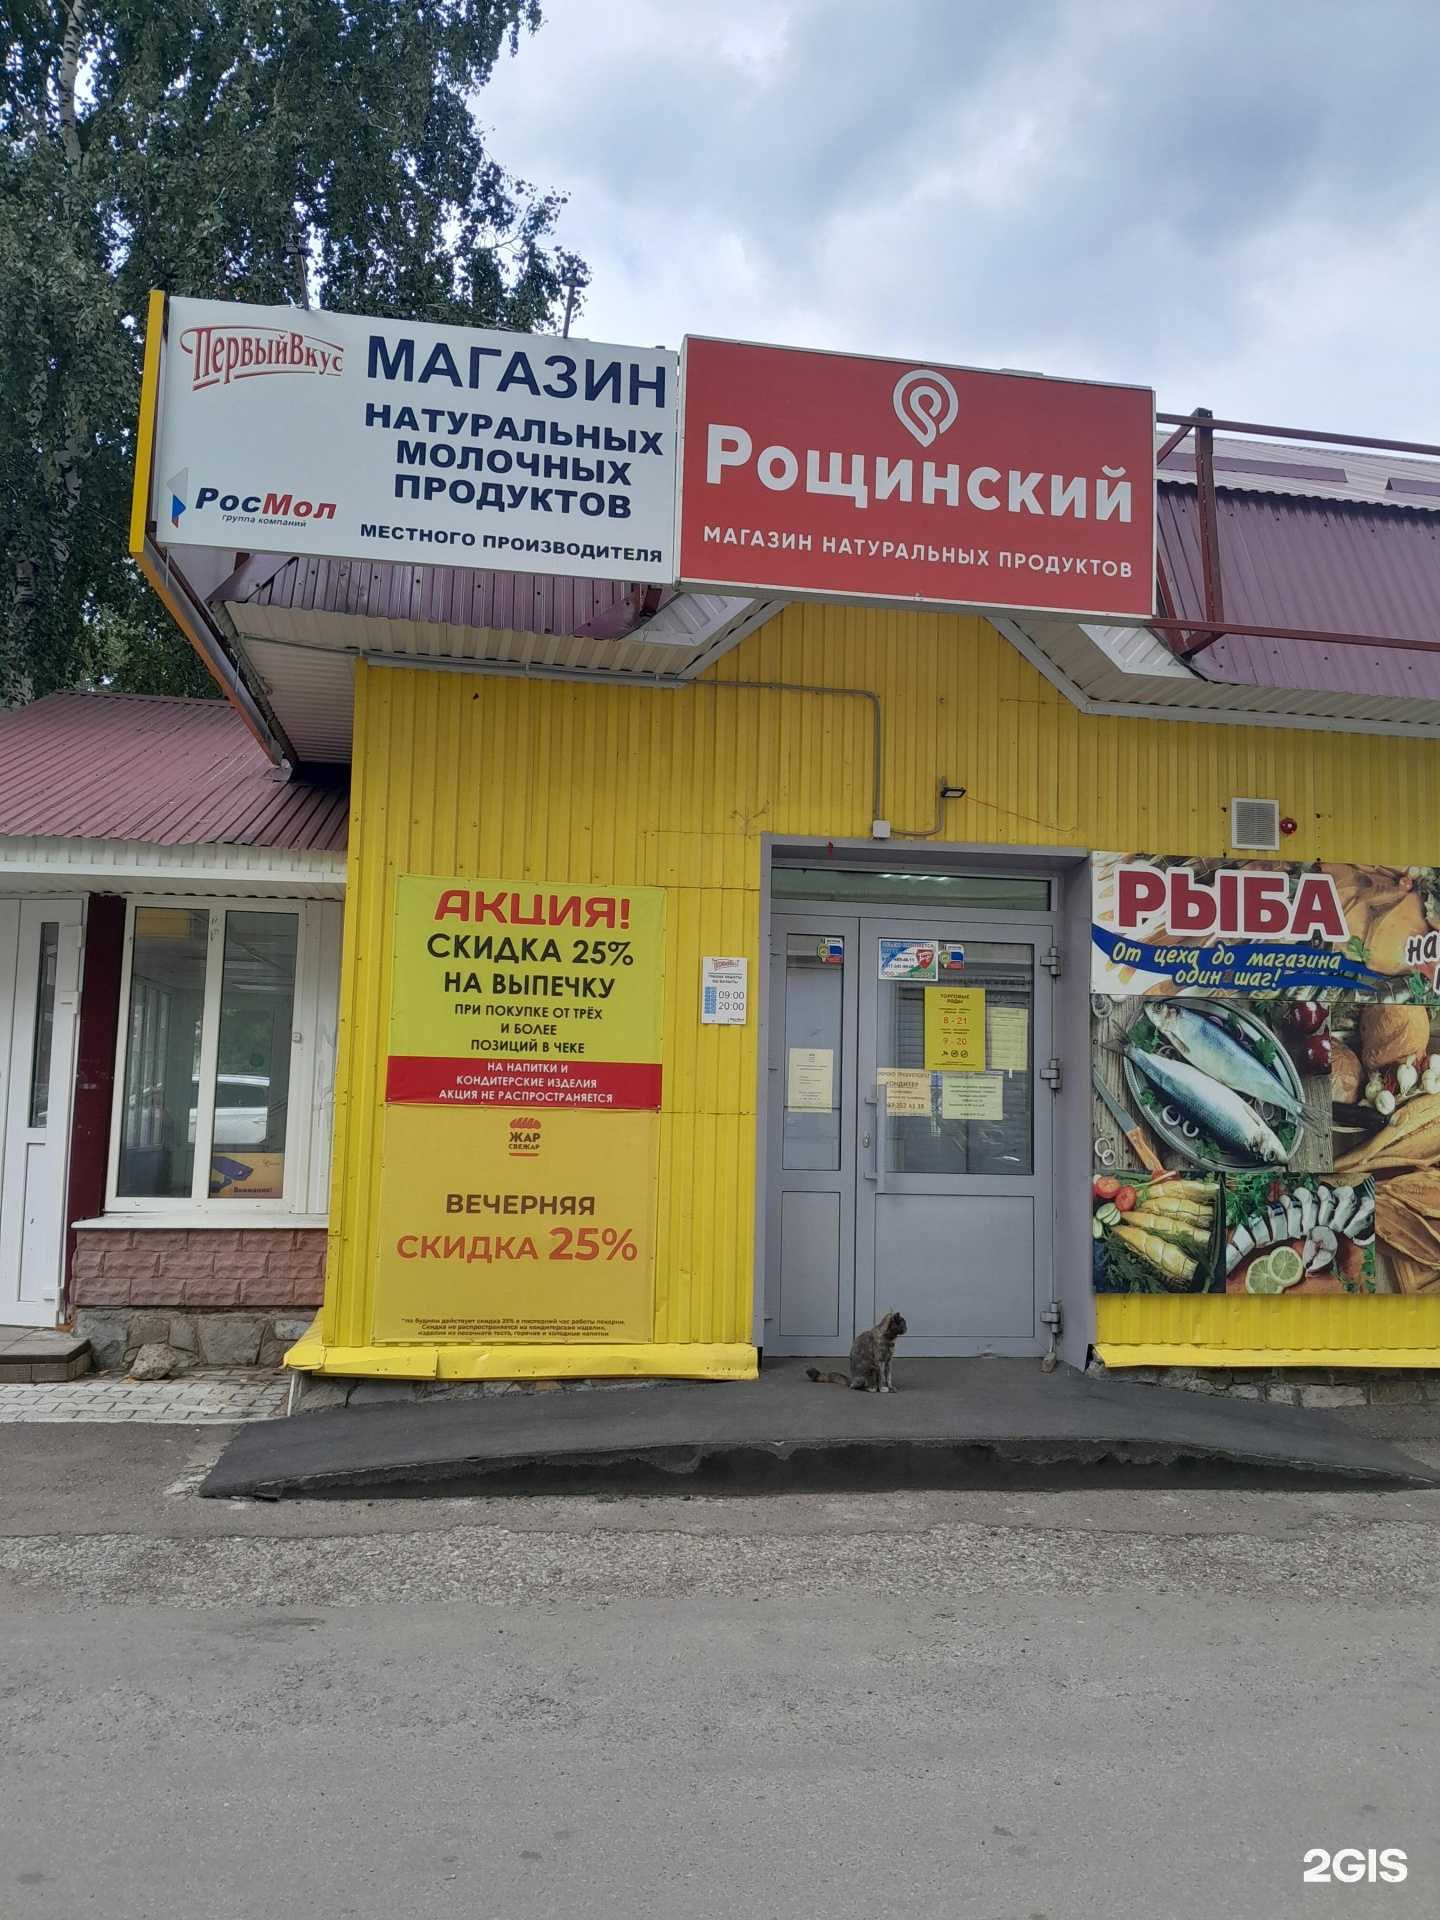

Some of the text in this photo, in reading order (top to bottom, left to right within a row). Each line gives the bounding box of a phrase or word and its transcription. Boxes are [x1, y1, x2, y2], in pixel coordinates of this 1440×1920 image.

[367, 335, 666, 408] МАГАЗИН
[365, 403, 663, 455] НАТУРАЛЬНЫХ
[396, 440, 632, 486] МОЛОЧНЫХ
[195, 487, 337, 520] РосМол
[395, 474, 631, 518] ПРОДУКТОВ
[222, 513, 307, 528] группа компаний
[360, 523, 662, 563] МЕСТНОГО ПРОИЗВОДИТЕЛЯ
[704, 526, 1132, 578] МАГАЗИН НАТУРАЛЬНЫХ ПРОДУКТОВ
[434, 889, 630, 930] АКЦИЯ!
[1118, 870, 1345, 935] РЫБА
[428, 933, 634, 966] СКИДКА 25%
[1113, 942, 1340, 970] От цеха до магазина
[445, 972, 615, 999] НА ВЫПЕЧКУ
[1176, 968, 1280, 988] один шаг!
[718, 1002, 744, 1010] 20:00
[719, 991, 744, 999] 09:00
[455, 1004, 602, 1019] ПРИ ПОКУПКЕ ОТ ТРЁХ
[501, 1024, 557, 1036] И БОЛЕЕ
[471, 1038, 584, 1054] ПОЗИЦИЙ В ЧЕКЕ
[488, 1063, 568, 1073] НА НАПИТКИ И
[456, 1075, 597, 1089] КОНДИТЕРСКИЕ ИЗДЕЛИЯ
[439, 1090, 612, 1103] АКЦИЯ НЕ РАСПРОСТРАНЯЕТСЯ
[510, 1132, 540, 1142] ЖАР
[446, 1194, 595, 1215] ВЕЧЕРНЯЯ
[396, 1227, 637, 1264] СКИДКА 25%
